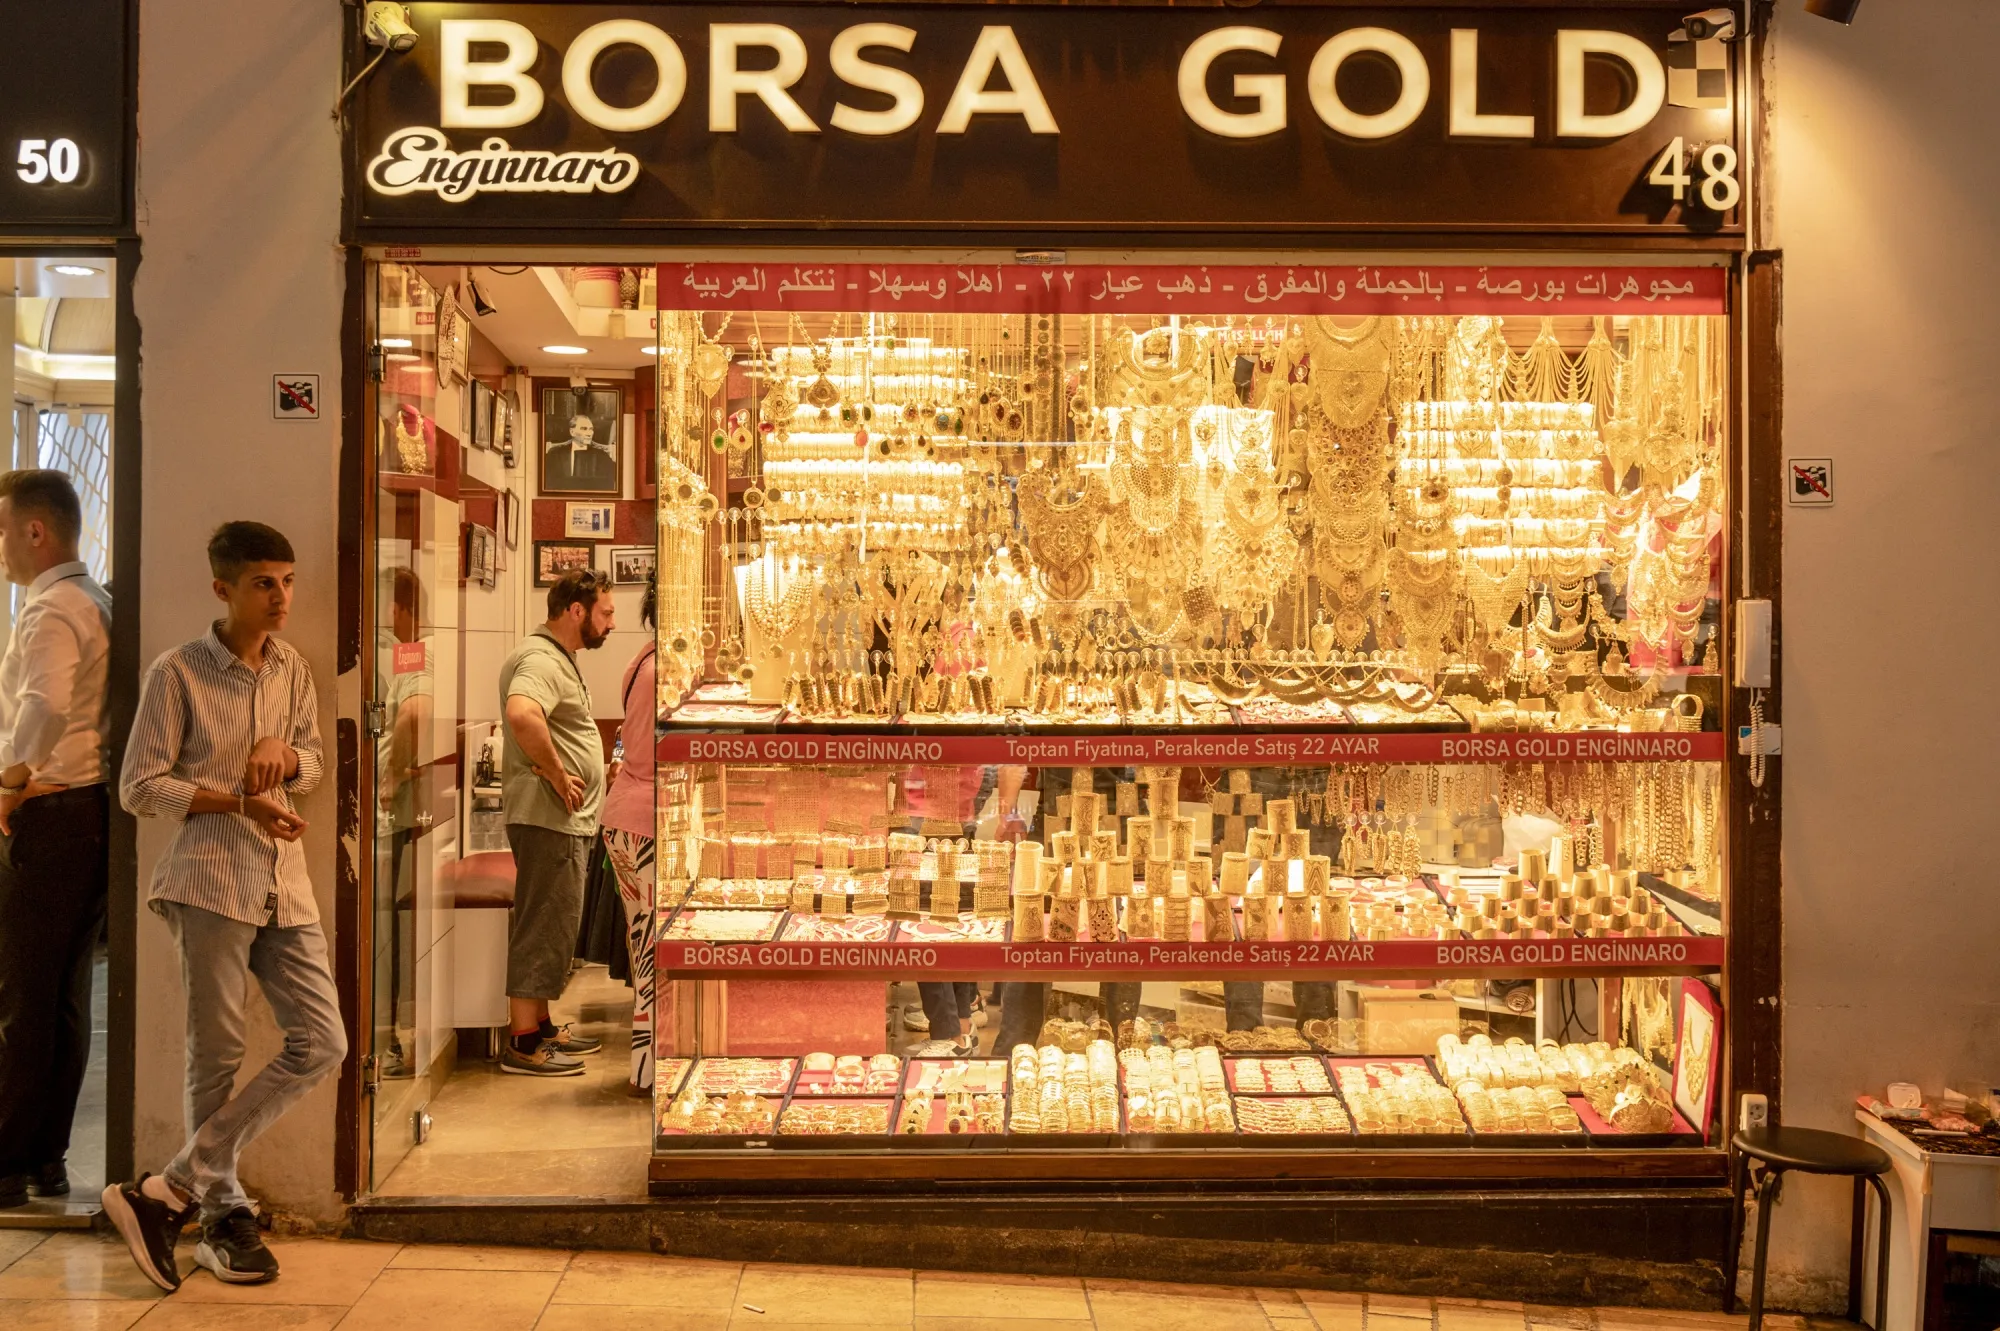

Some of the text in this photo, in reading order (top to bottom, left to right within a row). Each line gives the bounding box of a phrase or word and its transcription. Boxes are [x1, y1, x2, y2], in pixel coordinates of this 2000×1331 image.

[440, 18, 1666, 139] BORSA GOLD
[16, 138, 80, 184] 50
[370, 130, 635, 198] Enginnaro
[1648, 136, 1741, 212] 48
[683, 263, 766, 299] العربية
[777, 267, 836, 303] نتكلم
[1090, 270, 1144, 301] عيار
[1156, 266, 1212, 301] ذهب
[1244, 269, 1346, 304] والمفرق
[1355, 266, 1444, 302] بالجملة
[1476, 266, 1566, 302] بورصة
[1575, 271, 1695, 302] مجوهرات
[689, 740, 759, 759] BORSA
[763, 740, 819, 760] GOLD
[1006, 737, 1380, 762] Toptan Fiyatına, Perakende Satış 22 AYAR
[1442, 734, 1692, 757] BORSA GOLD ENGİNNARO
[684, 947, 753, 965] BORSA
[758, 947, 814, 966] GOLD
[1001, 944, 1375, 968] Toptan Fiyatına, Perakende Satış 22 AYAR
[1437, 939, 1687, 964] BORSA GOLD ENGİNNARO
